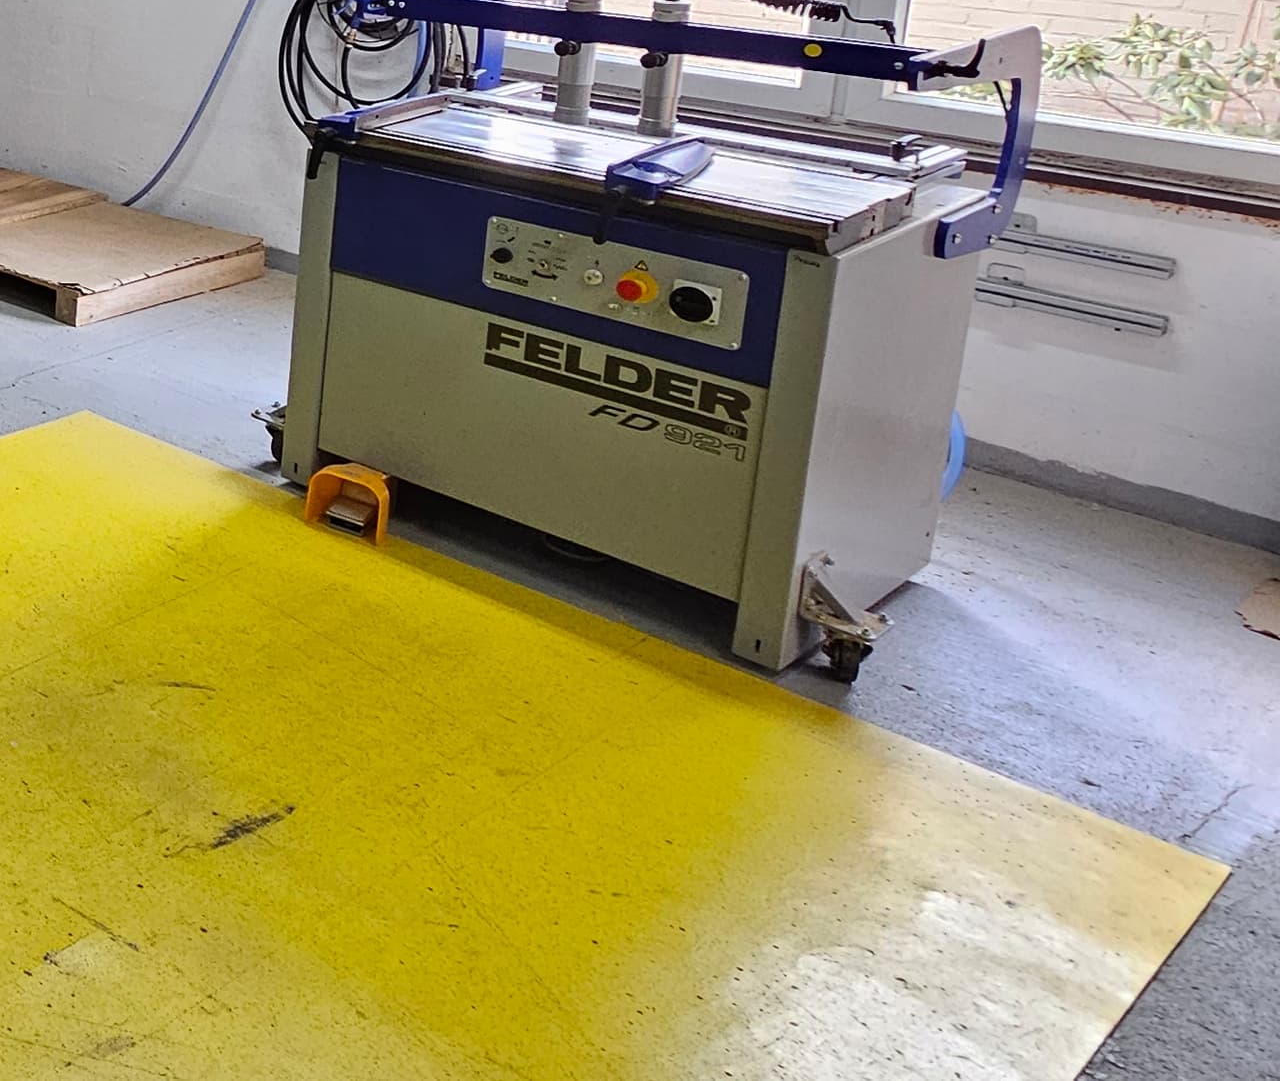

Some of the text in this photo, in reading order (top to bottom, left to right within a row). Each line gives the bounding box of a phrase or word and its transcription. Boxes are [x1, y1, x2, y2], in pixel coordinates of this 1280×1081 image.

[485, 322, 752, 427] FELDER
[588, 404, 746, 462] FD 921
